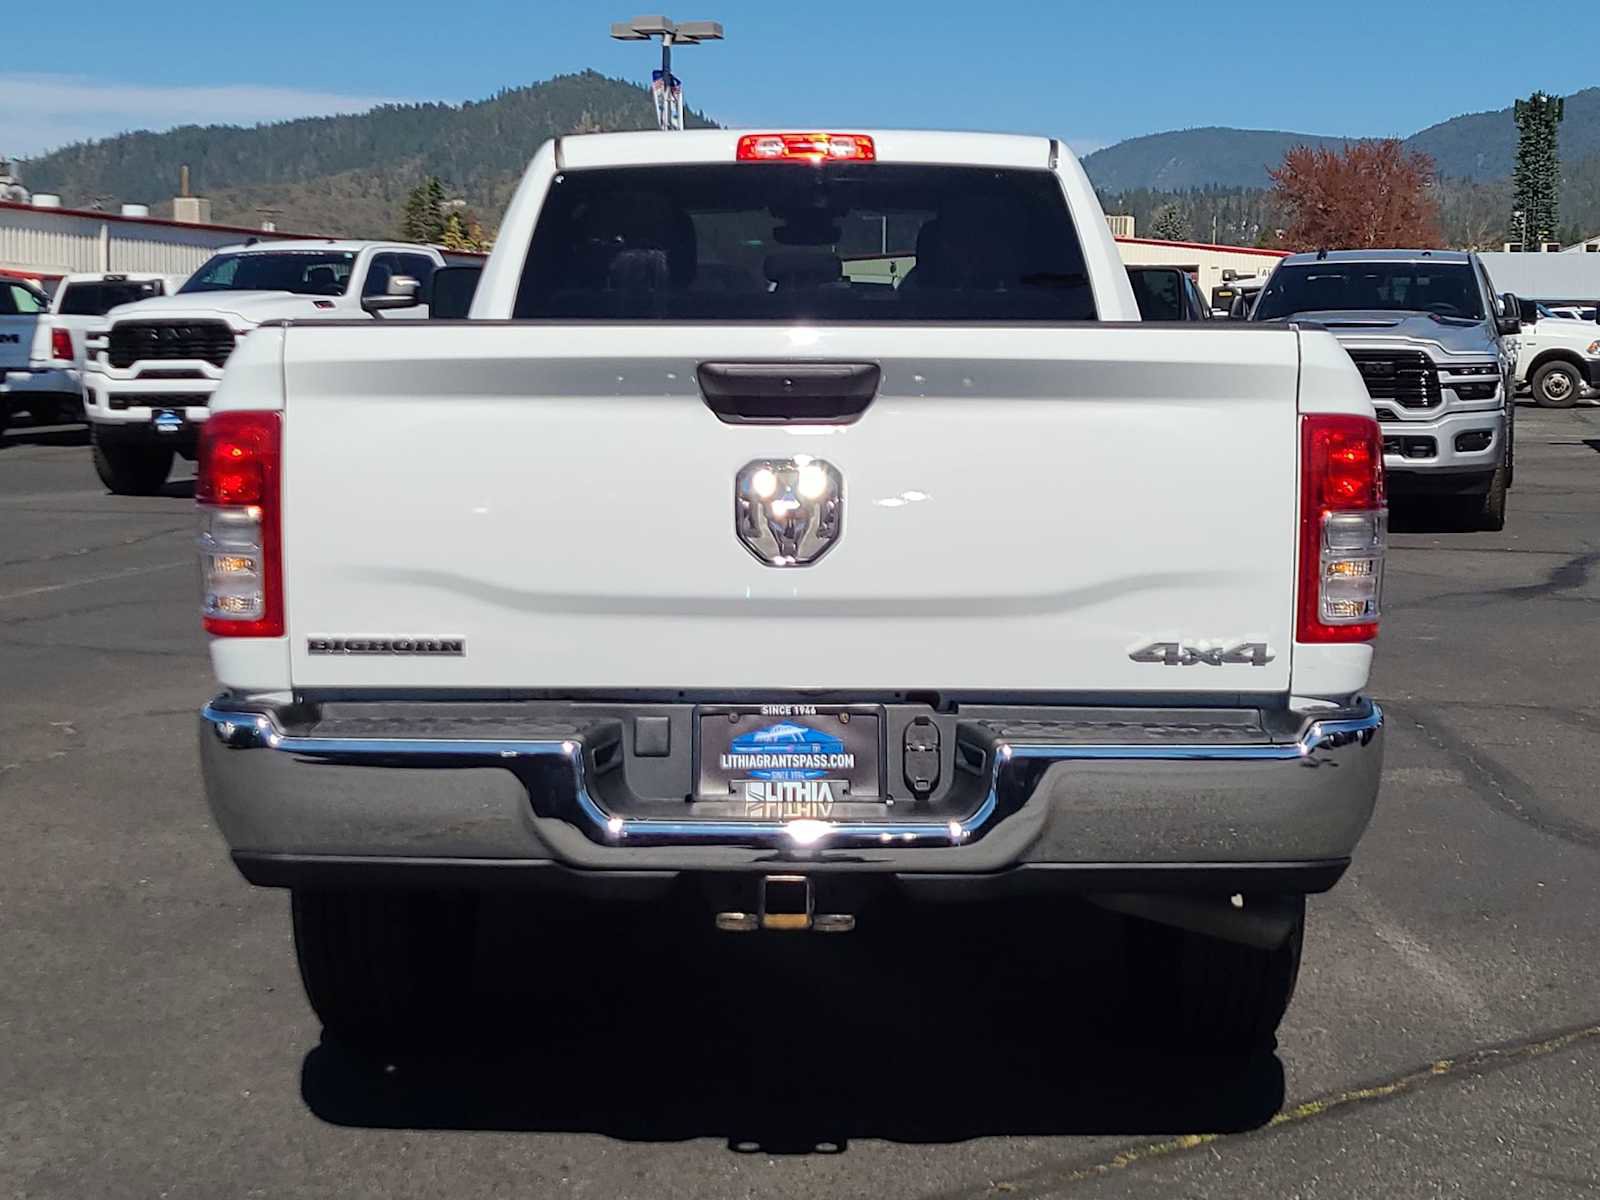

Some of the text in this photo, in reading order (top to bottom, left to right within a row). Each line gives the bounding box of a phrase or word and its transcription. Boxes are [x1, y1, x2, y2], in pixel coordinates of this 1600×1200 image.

[761, 704, 817, 716] SINCE 1946
[721, 753, 855, 769] LITHIAGRANTSPASS.COM
[765, 781, 834, 802] LITHIA
